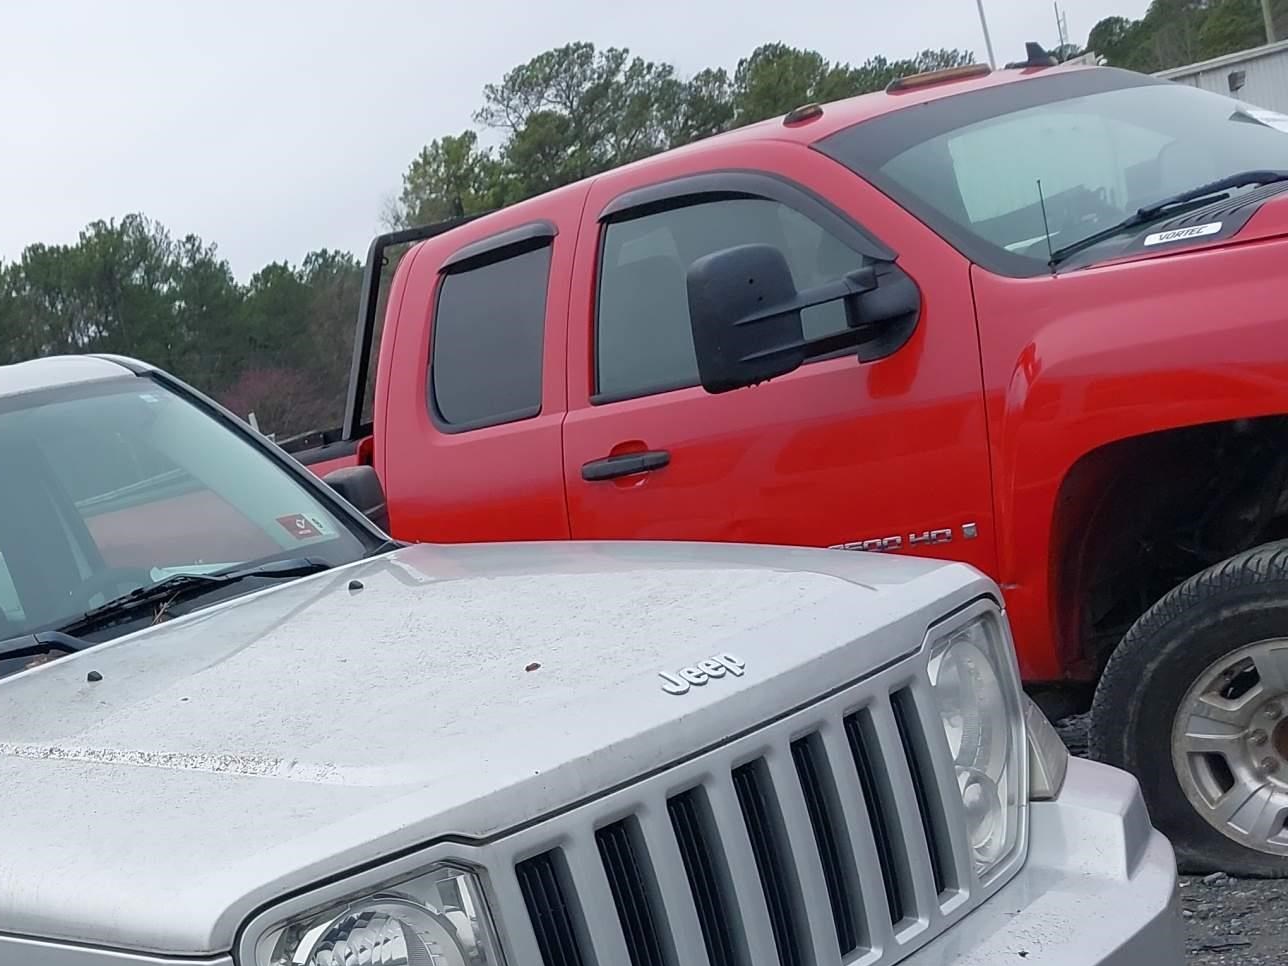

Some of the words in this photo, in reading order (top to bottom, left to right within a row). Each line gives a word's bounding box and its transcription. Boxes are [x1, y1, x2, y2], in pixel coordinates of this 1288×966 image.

[1159, 226, 1208, 240] VORTEC
[909, 528, 953, 546] HD
[658, 653, 746, 696] Jeep
